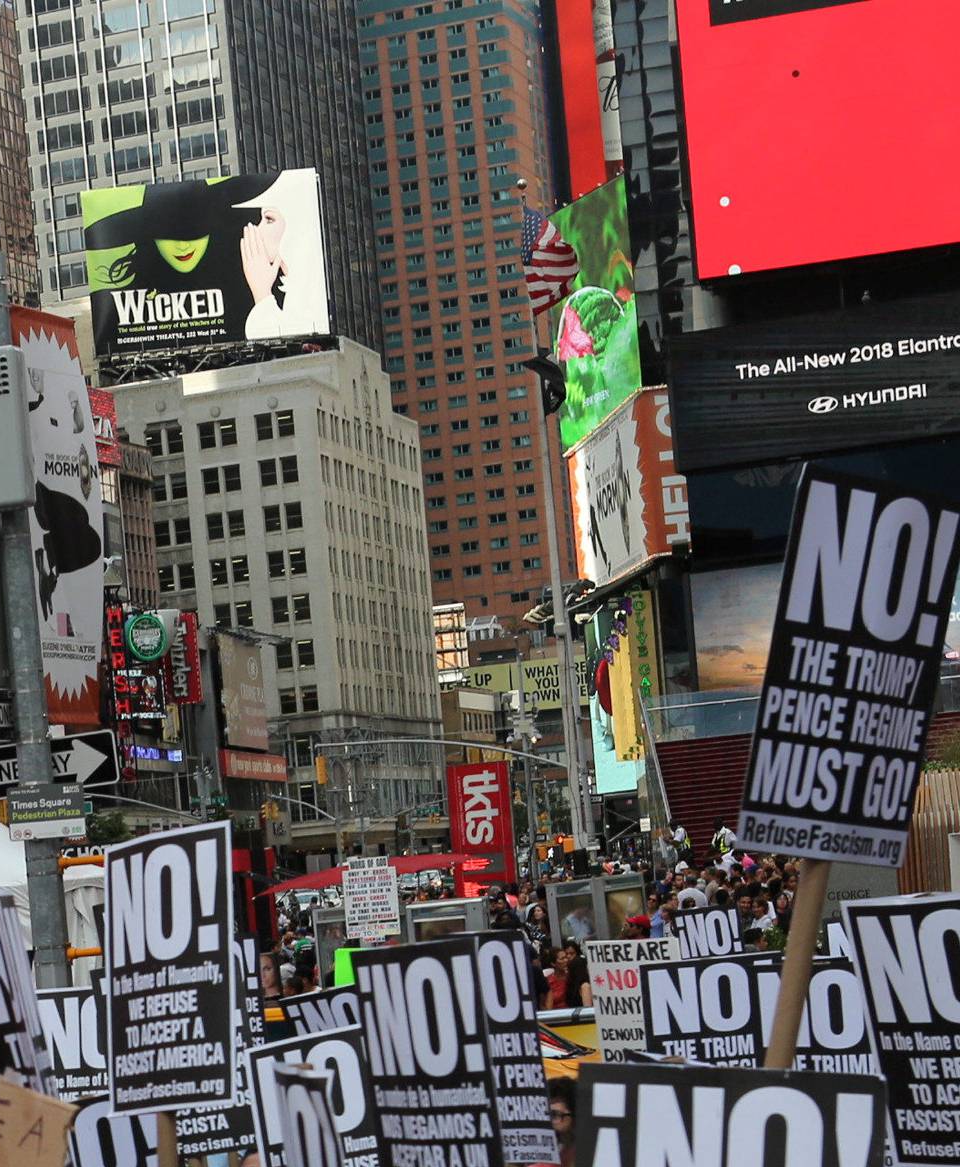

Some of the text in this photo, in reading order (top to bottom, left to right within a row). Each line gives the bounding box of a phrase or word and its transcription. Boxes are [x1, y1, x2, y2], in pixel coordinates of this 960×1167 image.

[736, 362, 770, 380] The
[774, 352, 846, 375] All-New
[850, 343, 894, 363] 2018
[843, 384, 927, 408] HYUNDAI
[785, 479, 960, 648] NO!
[475, 673, 492, 687] UP
[525, 664, 559, 679] WHAT
[535, 677, 559, 690] YOU
[789, 637, 925, 706] THE TRUMP/
[762, 685, 926, 752] PENCE REGIME
[749, 738, 917, 822] MUST GO!
[11, 808, 81, 821] Pedestrian Plaza
[12, 798, 72, 810] Times Square
[462, 770, 499, 845] tkts
[742, 814, 902, 865] RefuseFascism.org
[110, 838, 220, 968] NO!
[675, 909, 745, 960] ¡NO!
[588, 941, 671, 963] THERE ARE
[156, 967, 167, 988] of
[168, 961, 223, 985] Humanity,
[128, 989, 198, 1021] WE REFUSE
[357, 955, 486, 1077] ¡NO!
[125, 1016, 205, 1049] TO ACCEPT A
[879, 1031, 951, 1052] In the Name
[115, 1042, 225, 1078] FASCIST AMERICA
[662, 1040, 697, 1057] THE
[505, 1064, 546, 1088] PENCE
[908, 1057, 940, 1080] WE
[116, 1077, 225, 1104] RefuseFascism.org
[908, 1083, 933, 1106] TO
[479, 1112, 493, 1139] A
